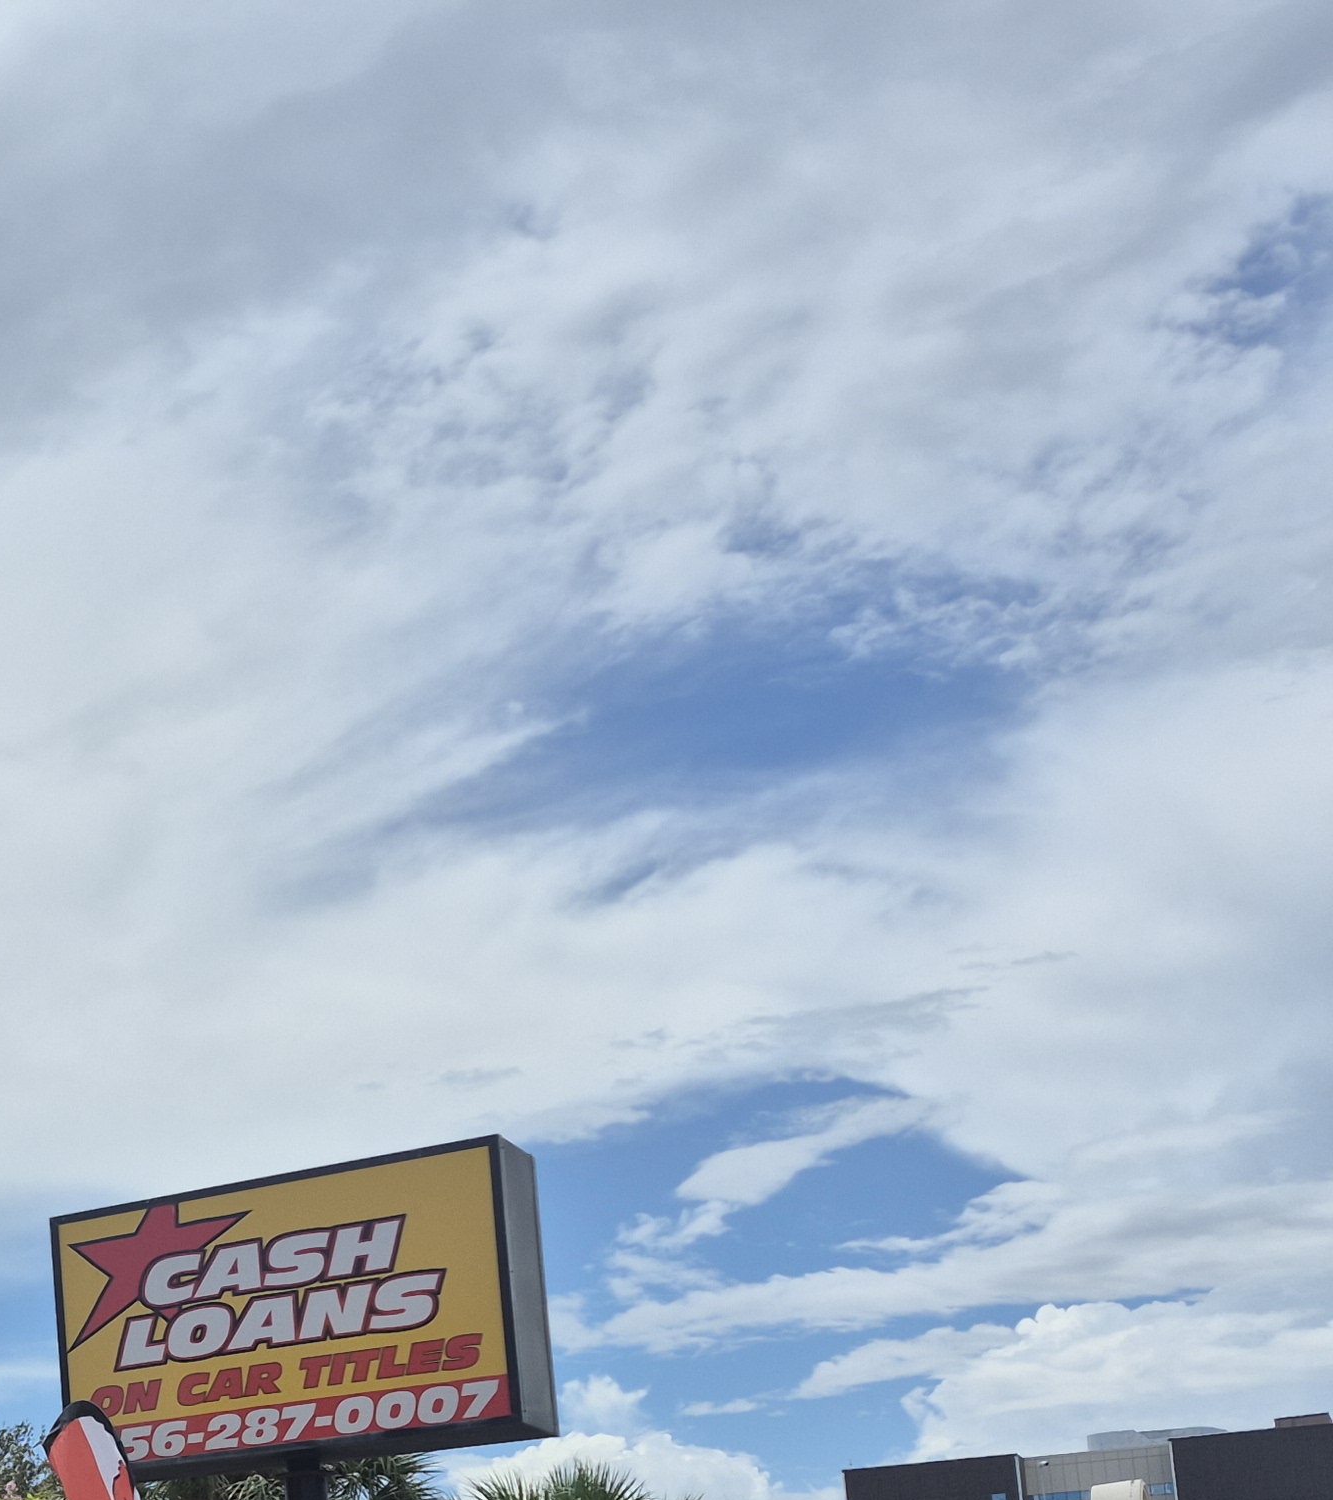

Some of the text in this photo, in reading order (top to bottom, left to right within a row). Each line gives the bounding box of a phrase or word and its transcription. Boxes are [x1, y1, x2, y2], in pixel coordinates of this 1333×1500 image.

[143, 1216, 405, 1306] CASH
[117, 1270, 444, 1370] LOANS
[91, 1333, 483, 1417] ON CAR TITLES
[123, 1380, 500, 1463] 56-287-0007
